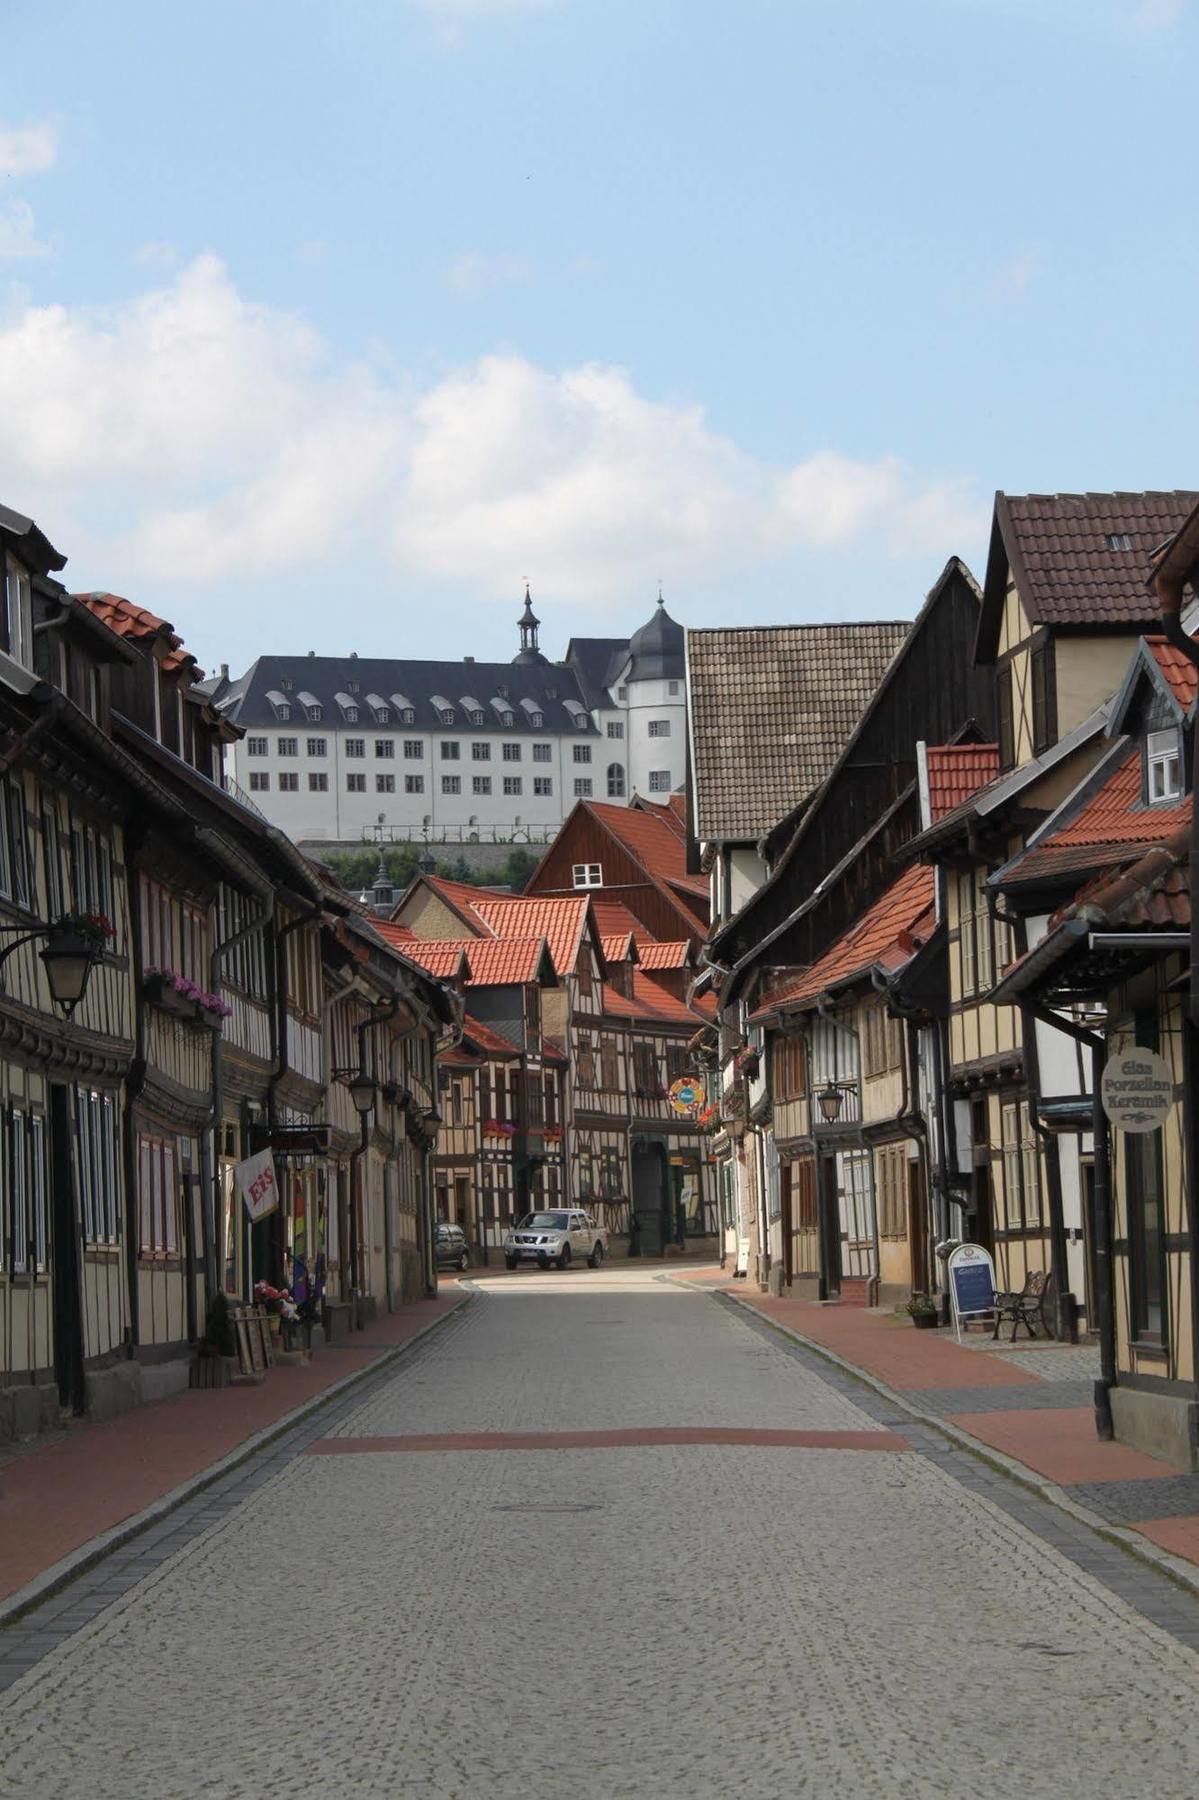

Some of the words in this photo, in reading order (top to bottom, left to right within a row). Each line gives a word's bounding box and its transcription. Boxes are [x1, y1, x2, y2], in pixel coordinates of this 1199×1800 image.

[1104, 1077, 1171, 1092] Porzellan
[1107, 1094, 1169, 1108] Keramik
[248, 1166, 274, 1206] Eis
